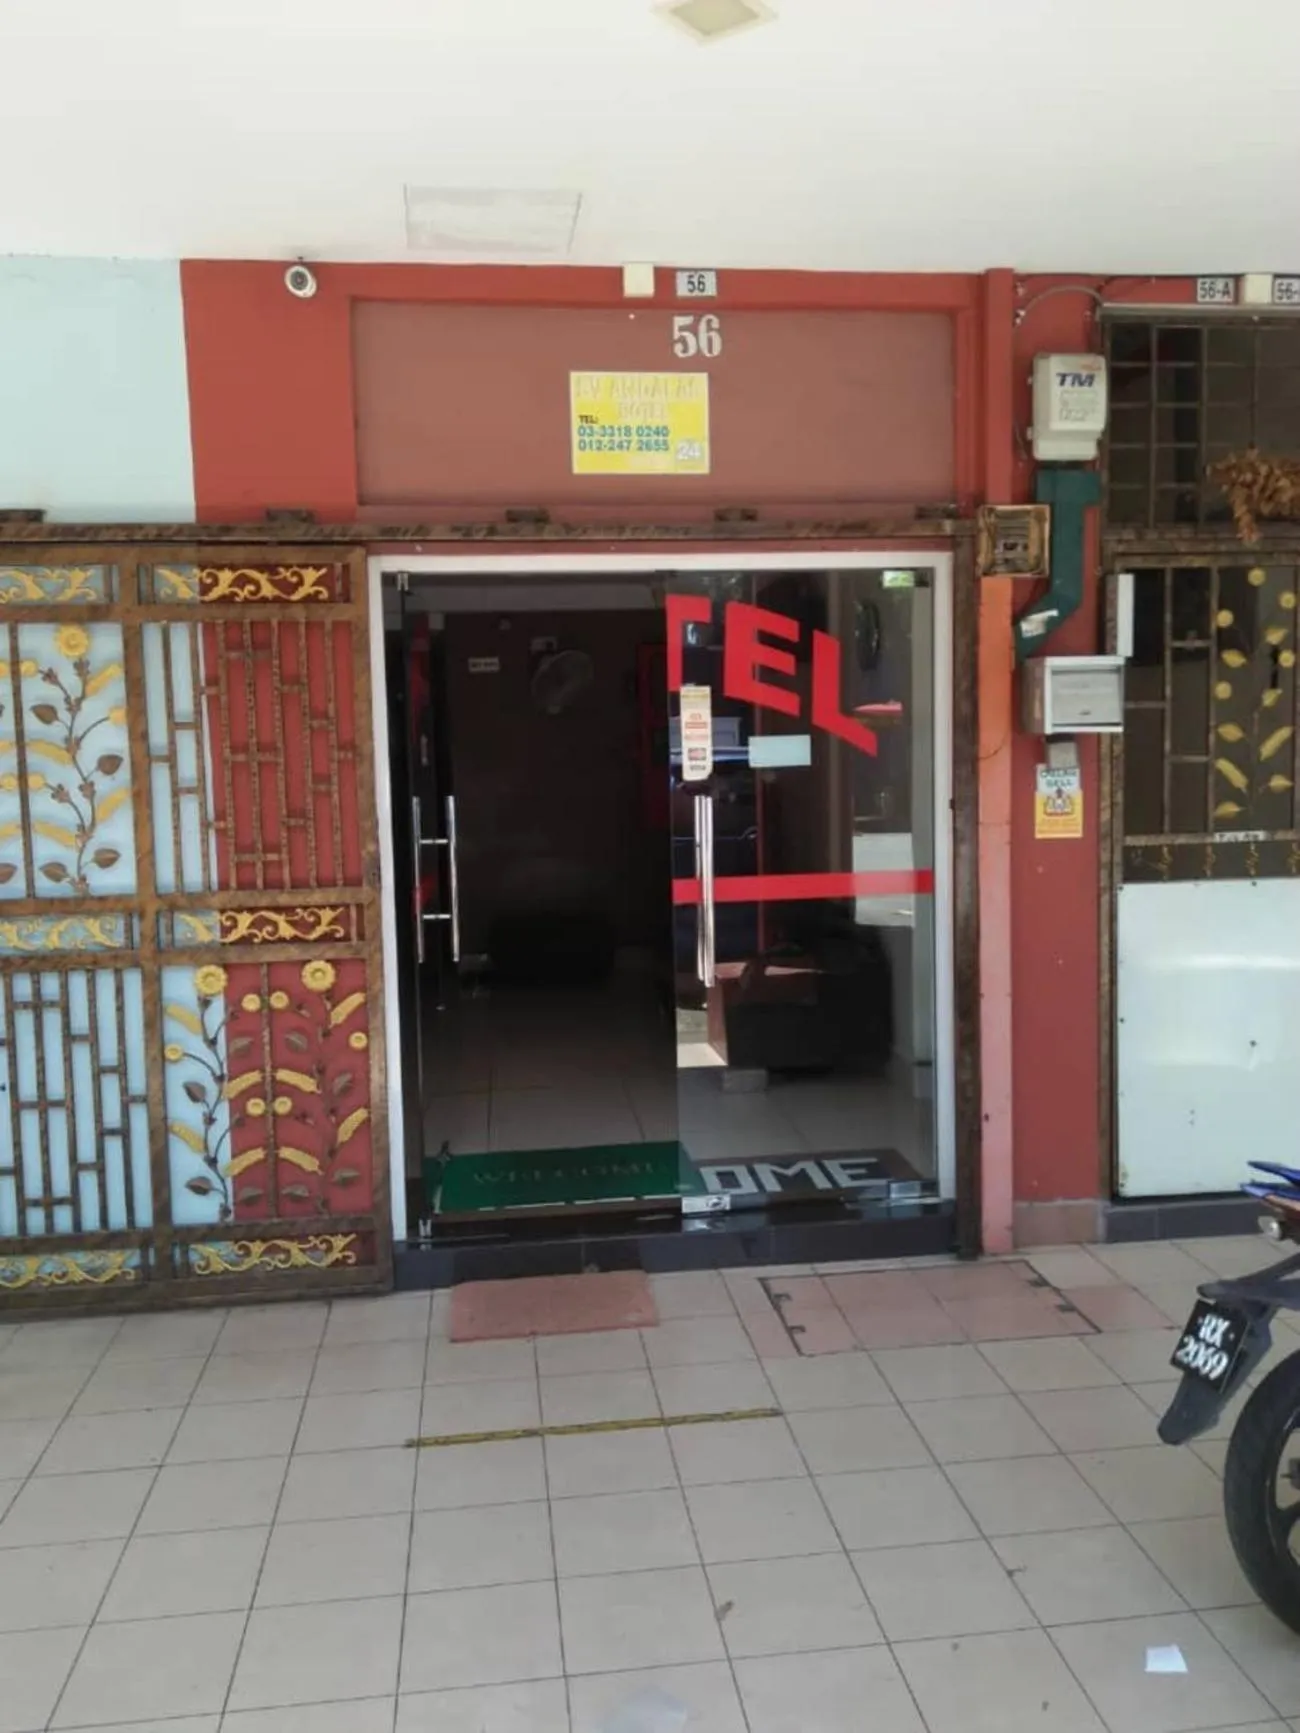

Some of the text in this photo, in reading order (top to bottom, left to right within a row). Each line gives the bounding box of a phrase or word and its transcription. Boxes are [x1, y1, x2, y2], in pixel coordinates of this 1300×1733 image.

[686, 274, 706, 293] 56
[1200, 281, 1230, 299] 56-A
[673, 314, 722, 358] 56
[1055, 372, 1095, 387] TM
[578, 415, 598, 424] TEL:
[635, 425, 669, 438] 0240
[578, 438, 632, 451] 012-247
